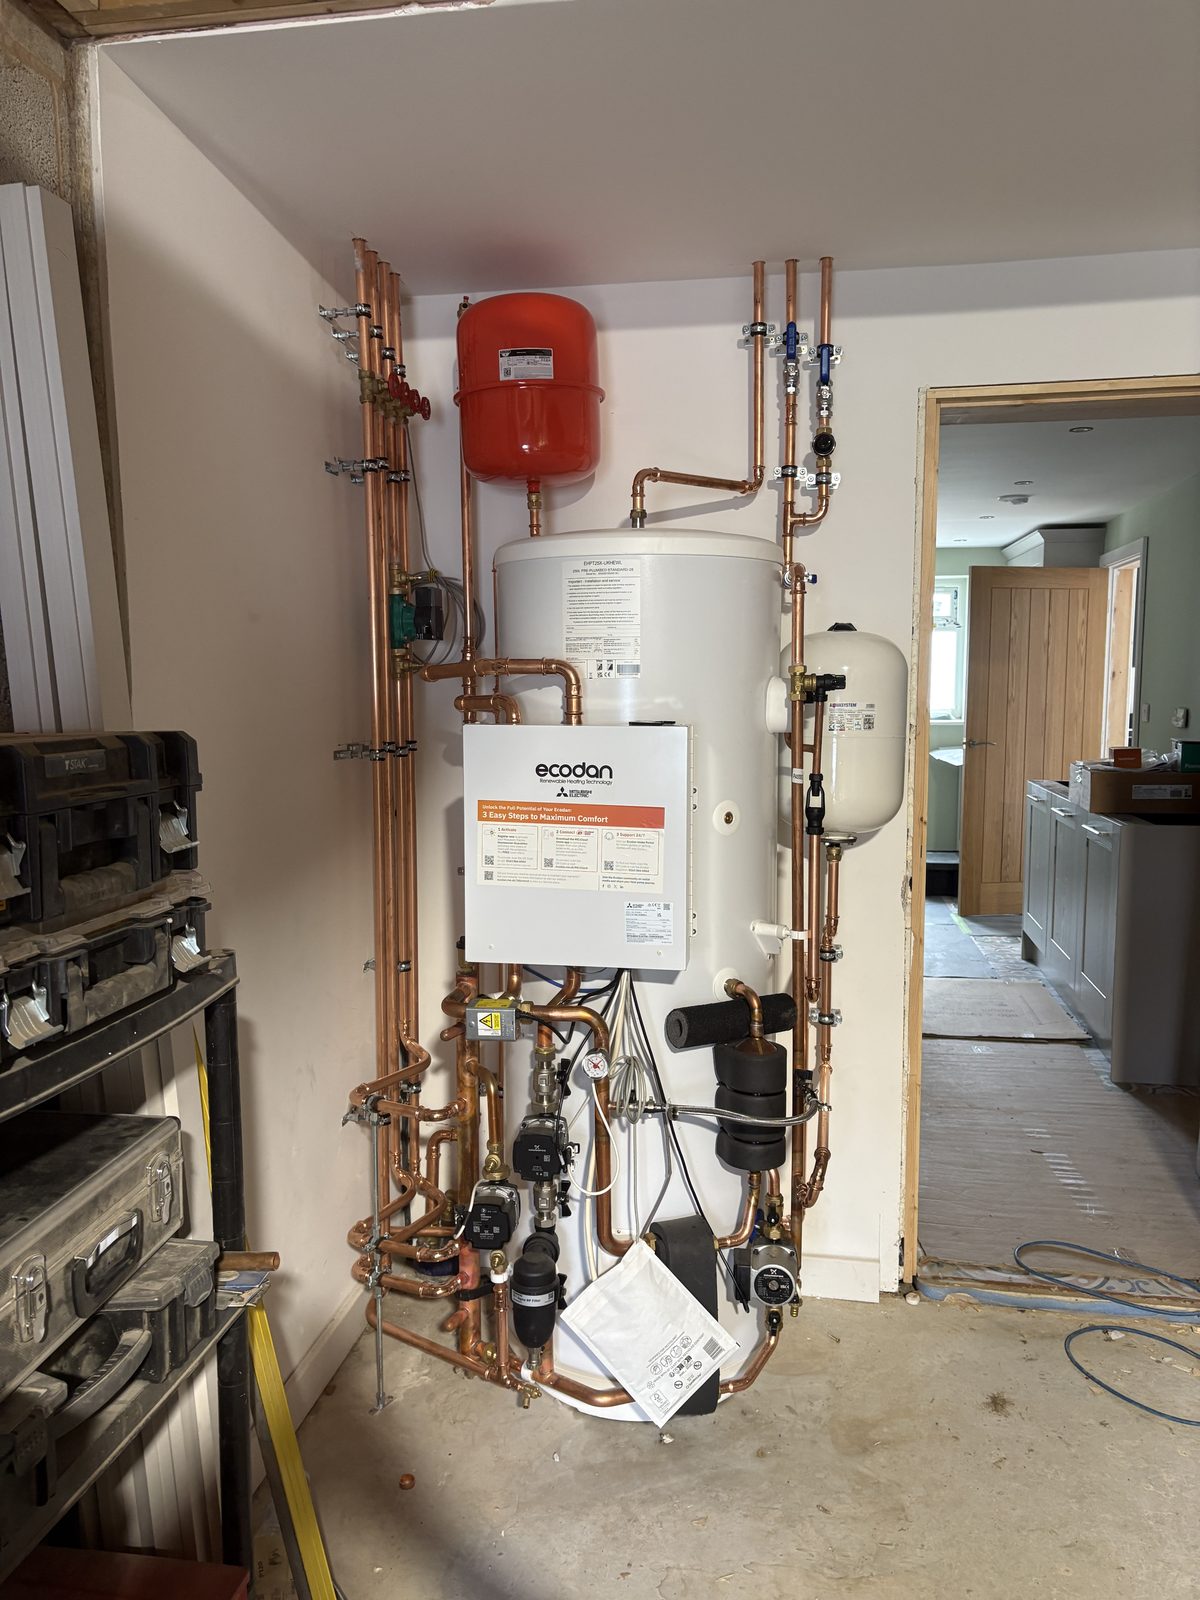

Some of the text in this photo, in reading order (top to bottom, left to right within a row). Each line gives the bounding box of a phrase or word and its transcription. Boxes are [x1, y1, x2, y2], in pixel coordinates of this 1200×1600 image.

[535, 761, 613, 779] ecodan
[489, 811, 506, 819] Easy
[508, 812, 529, 821] Steps
[578, 815, 608, 823] Comfort
